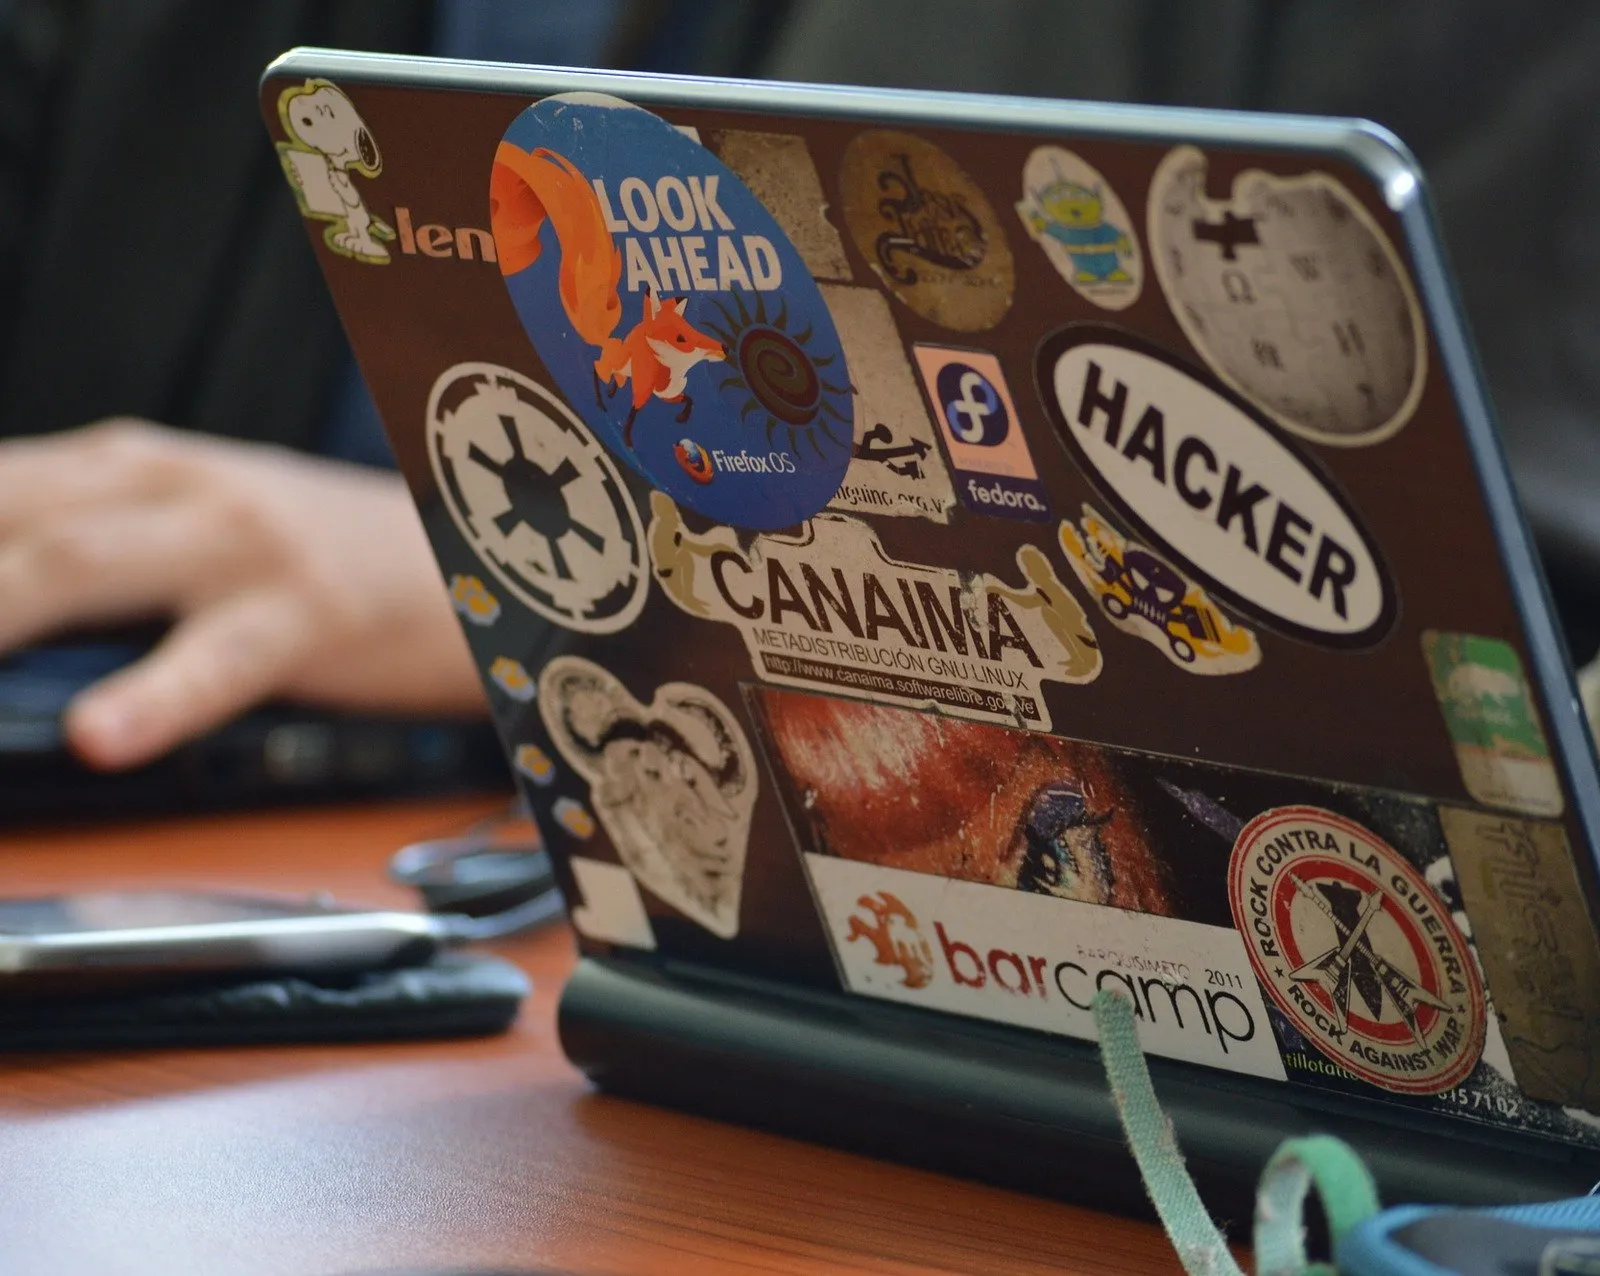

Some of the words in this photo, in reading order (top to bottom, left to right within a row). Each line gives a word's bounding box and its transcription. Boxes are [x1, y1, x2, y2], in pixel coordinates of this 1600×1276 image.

[593, 175, 736, 234] LOOK
[625, 235, 782, 293] AHEAD
[712, 449, 771, 474] Firefox
[769, 451, 796, 474] OS
[1077, 359, 1357, 622] HACKER
[710, 551, 1044, 669] CANAIMA
[752, 627, 925, 674] METADISTRIBUCIÓN
[928, 656, 969, 680] GNU
[970, 663, 1030, 691] LINUX
[764, 652, 1035, 715] http://www.canaima.softwarelibre.gove
[1256, 829, 1340, 877] CONTRA
[1349, 842, 1382, 877] LA
[1250, 876, 1280, 957] ROCK
[1390, 875, 1466, 995] GUERRA
[933, 921, 1255, 1054] barcamp
[1205, 968, 1243, 989] 2011
[1287, 984, 1348, 1046] ROCK
[1350, 1040, 1437, 1072] AGAINST
[1437, 1017, 1467, 1061] WAR
